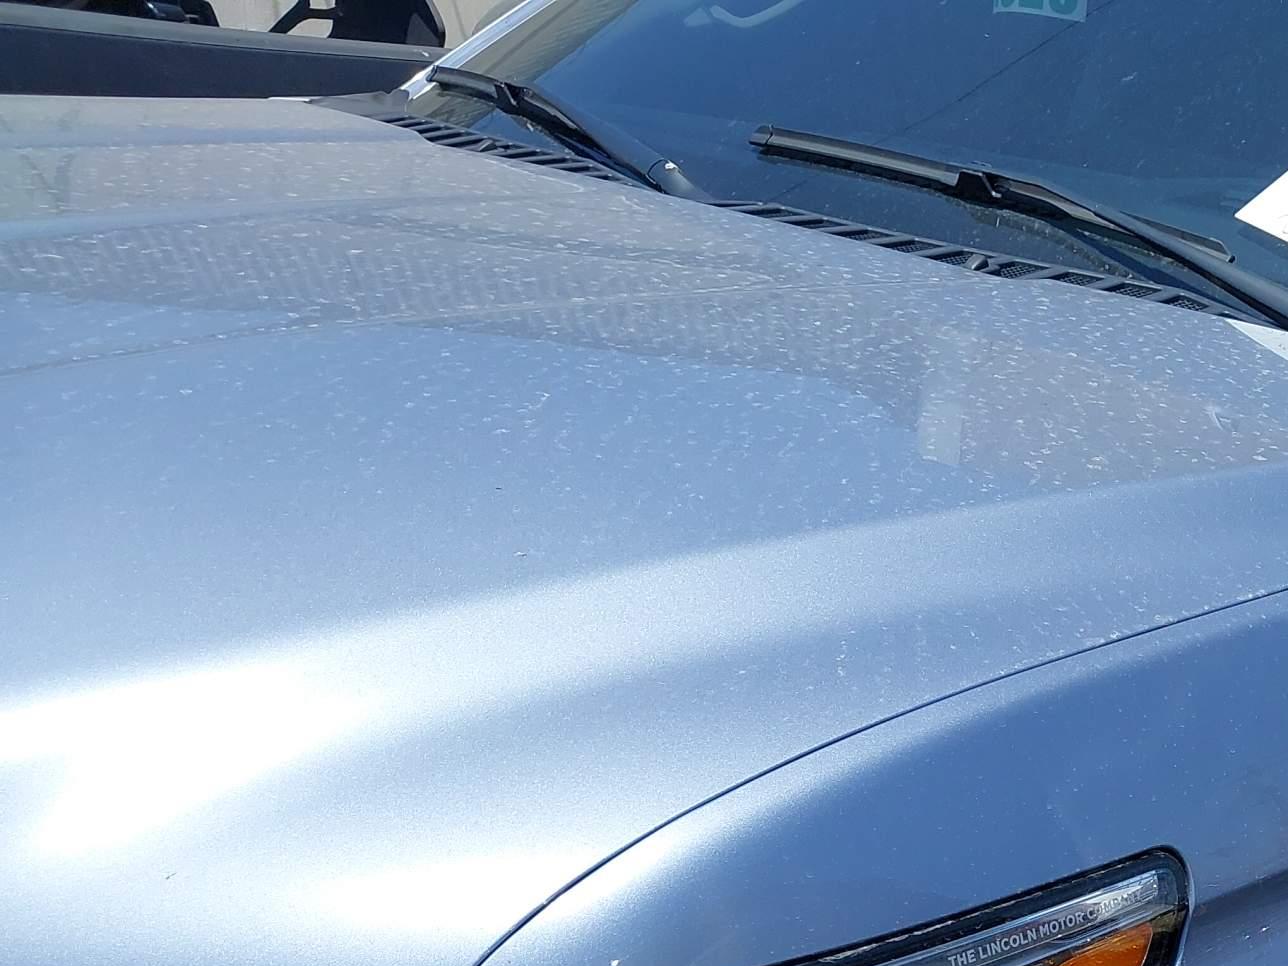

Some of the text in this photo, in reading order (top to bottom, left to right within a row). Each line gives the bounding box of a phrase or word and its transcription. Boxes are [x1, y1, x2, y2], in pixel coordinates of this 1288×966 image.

[977, 929, 1037, 960] LINCOLN
[1039, 912, 1085, 938] MOTOR
[1086, 890, 1143, 920] COMPANY
